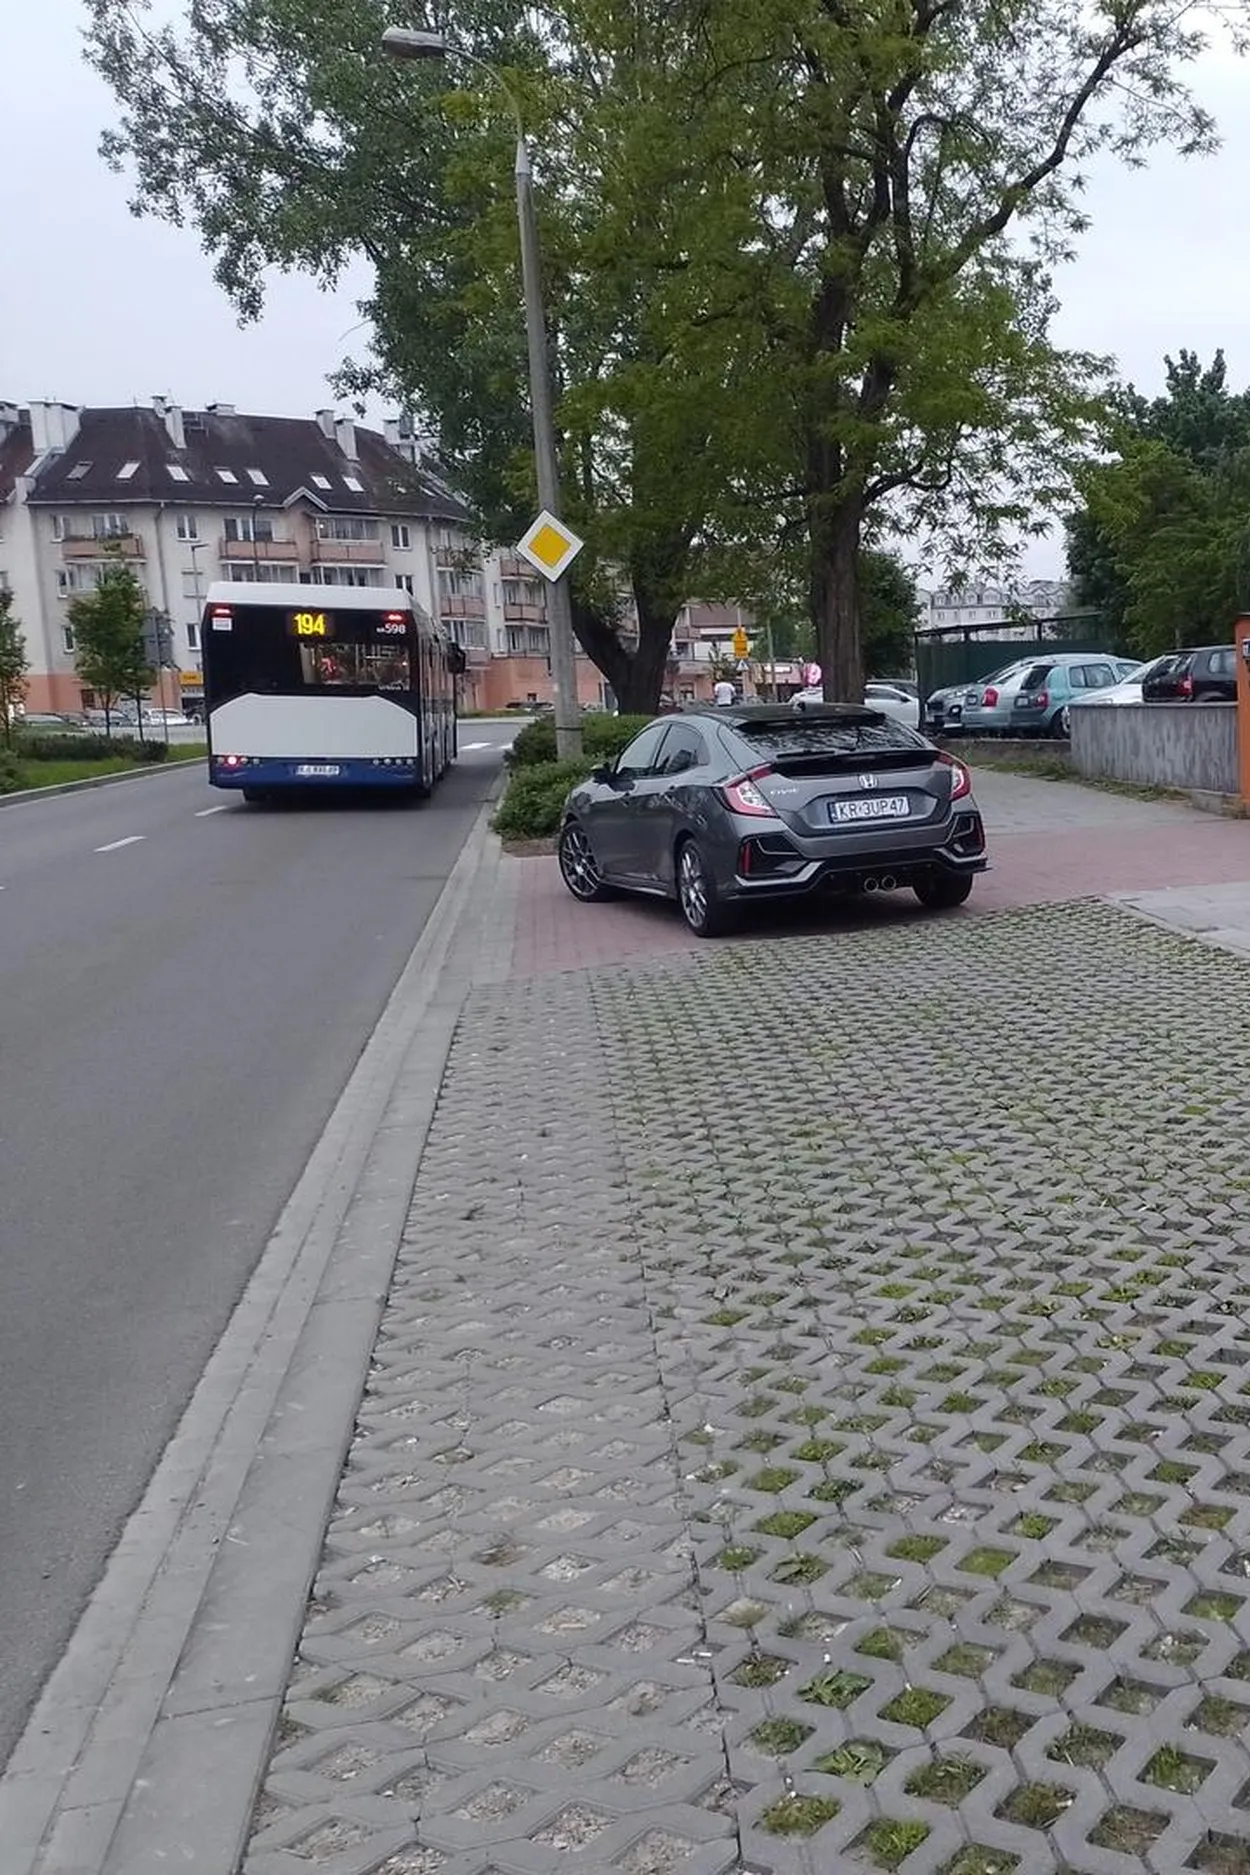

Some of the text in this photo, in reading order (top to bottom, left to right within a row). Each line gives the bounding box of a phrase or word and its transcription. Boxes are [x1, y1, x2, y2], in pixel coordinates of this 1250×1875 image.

[294, 613, 325, 636] 194
[839, 799, 904, 819] KR 3UP47
